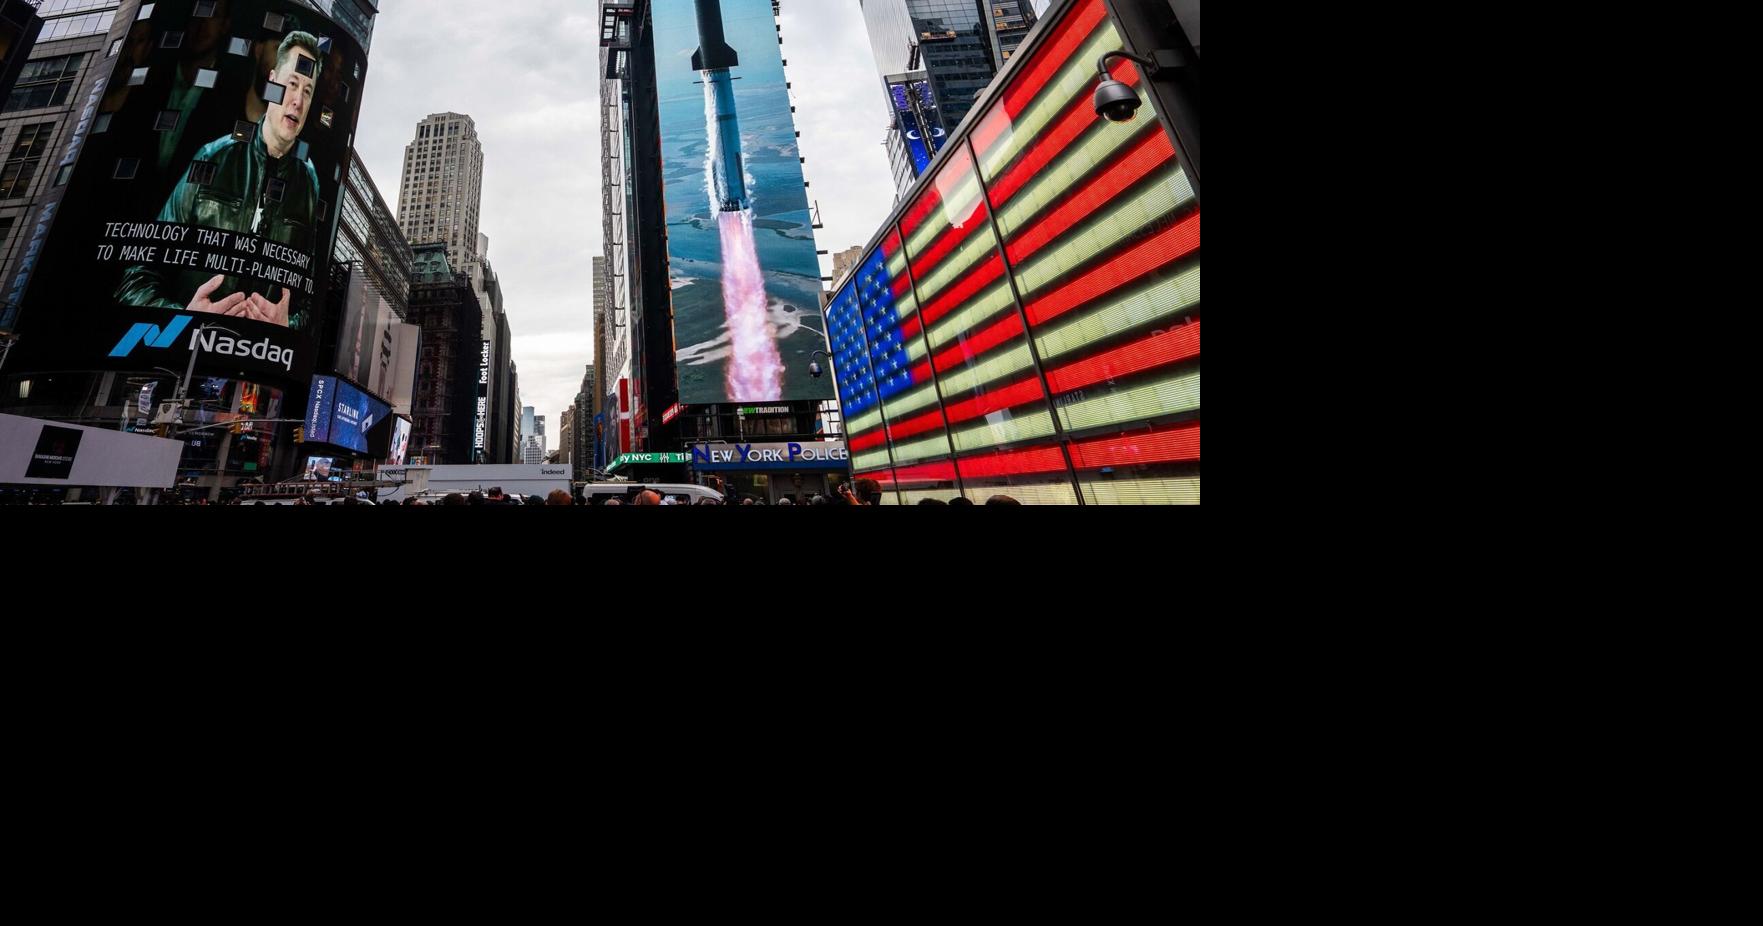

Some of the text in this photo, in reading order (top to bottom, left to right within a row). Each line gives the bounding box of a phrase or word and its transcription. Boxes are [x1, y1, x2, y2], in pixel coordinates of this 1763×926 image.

[104, 222, 311, 270] TECHNOLOGY THAT WAS NECESSARY
[96, 244, 315, 295] TO MAKE LIFE MULTI-PLANETARY TO.
[188, 328, 295, 371] Nasdaq
[479, 342, 490, 385] Foot Locker
[315, 379, 325, 400] SPCX
[338, 402, 360, 420] STARLINK
[477, 396, 487, 416] HERE
[474, 423, 484, 449] HOOPS
[632, 453, 652, 462] NYC
[693, 442, 848, 464] NEW YORK POLICE
[541, 468, 565, 477] indeed
